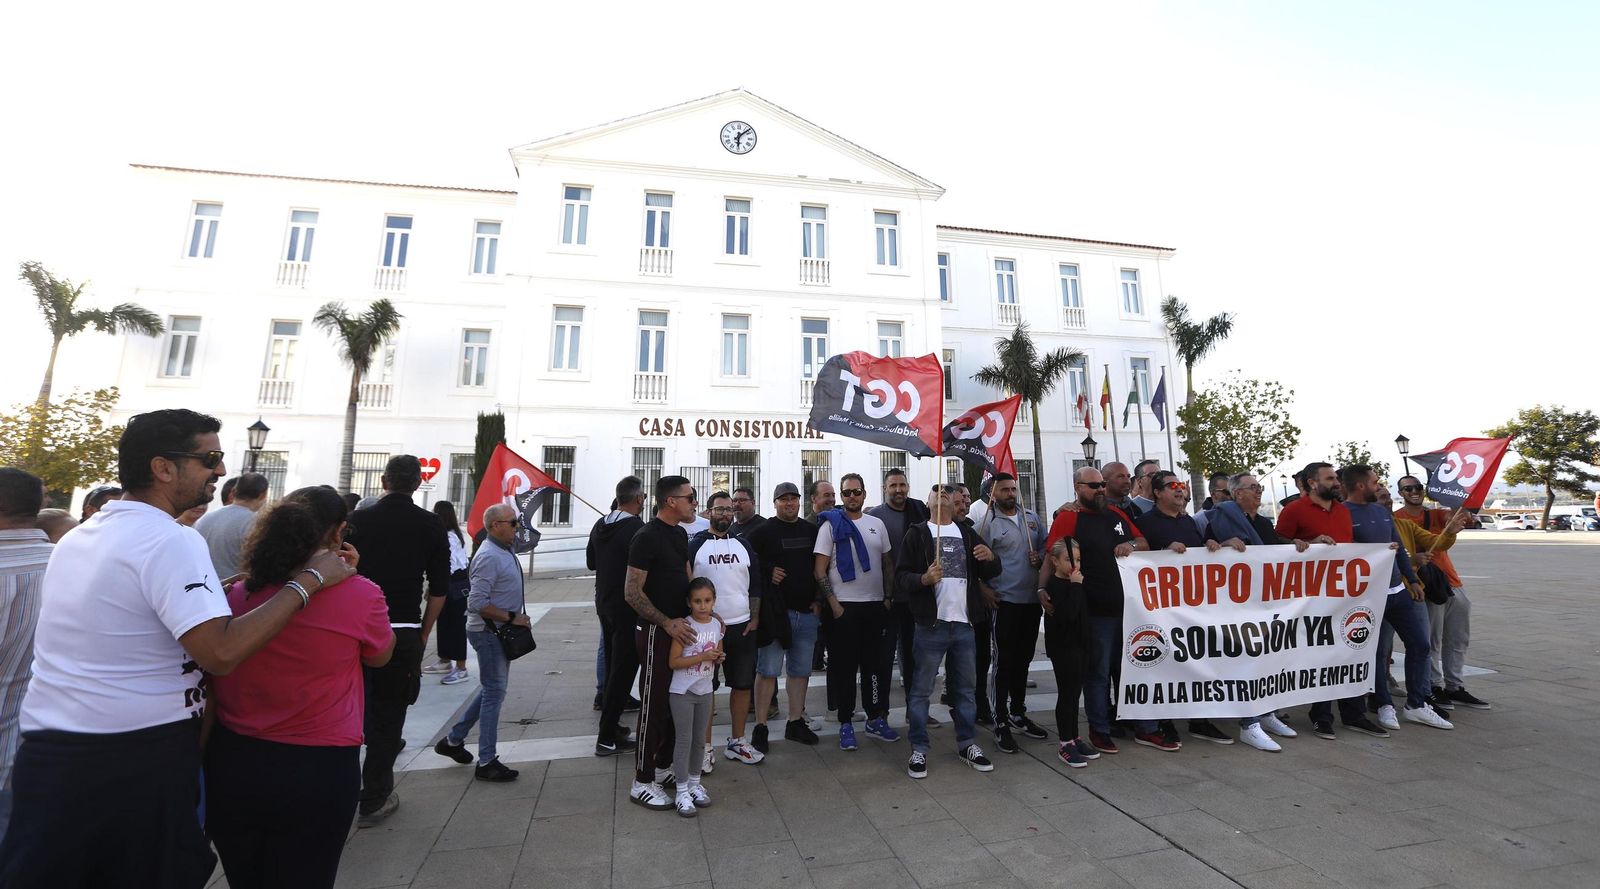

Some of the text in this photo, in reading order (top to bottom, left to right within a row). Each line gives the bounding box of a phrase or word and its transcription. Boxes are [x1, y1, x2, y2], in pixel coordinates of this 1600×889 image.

[639, 417, 686, 437] CASA
[708, 553, 740, 565] NASA
[1138, 557, 1371, 611] GRUPO NAVEC
[1170, 613, 1299, 662] SOLUCIÓN
[1303, 615, 1335, 647] YA
[1351, 629, 1368, 638] CGT
[1137, 648, 1157, 657] CGT
[1125, 661, 1369, 704] NO A LA DESTRUCCIÓN DE EMPLEO
